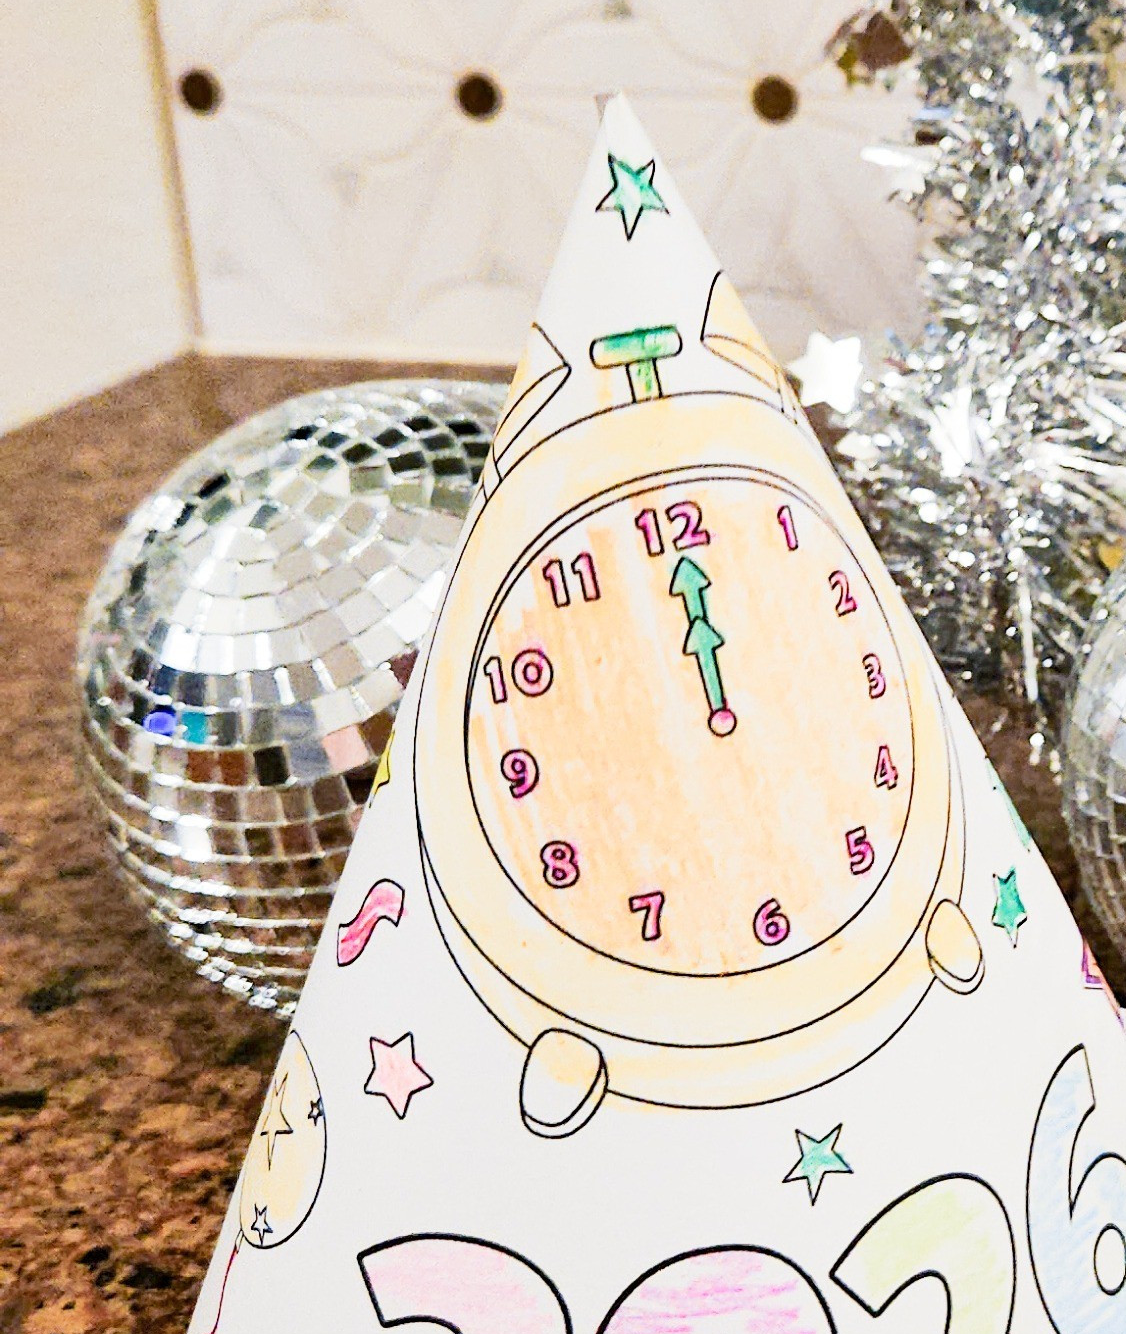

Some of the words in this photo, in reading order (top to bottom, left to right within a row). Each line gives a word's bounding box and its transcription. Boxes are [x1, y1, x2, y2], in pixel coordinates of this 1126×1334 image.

[634, 500, 711, 557] 12
[777, 505, 799, 551] 1
[542, 552, 600, 607] 11
[829, 570, 857, 617] 2
[483, 648, 554, 703] 10
[863, 653, 886, 699] 3
[501, 749, 539, 798] 9
[874, 746, 898, 790] 4
[540, 840, 580, 889] 8
[845, 826, 875, 875] 5
[630, 891, 665, 941] 7
[753, 899, 790, 946] 6
